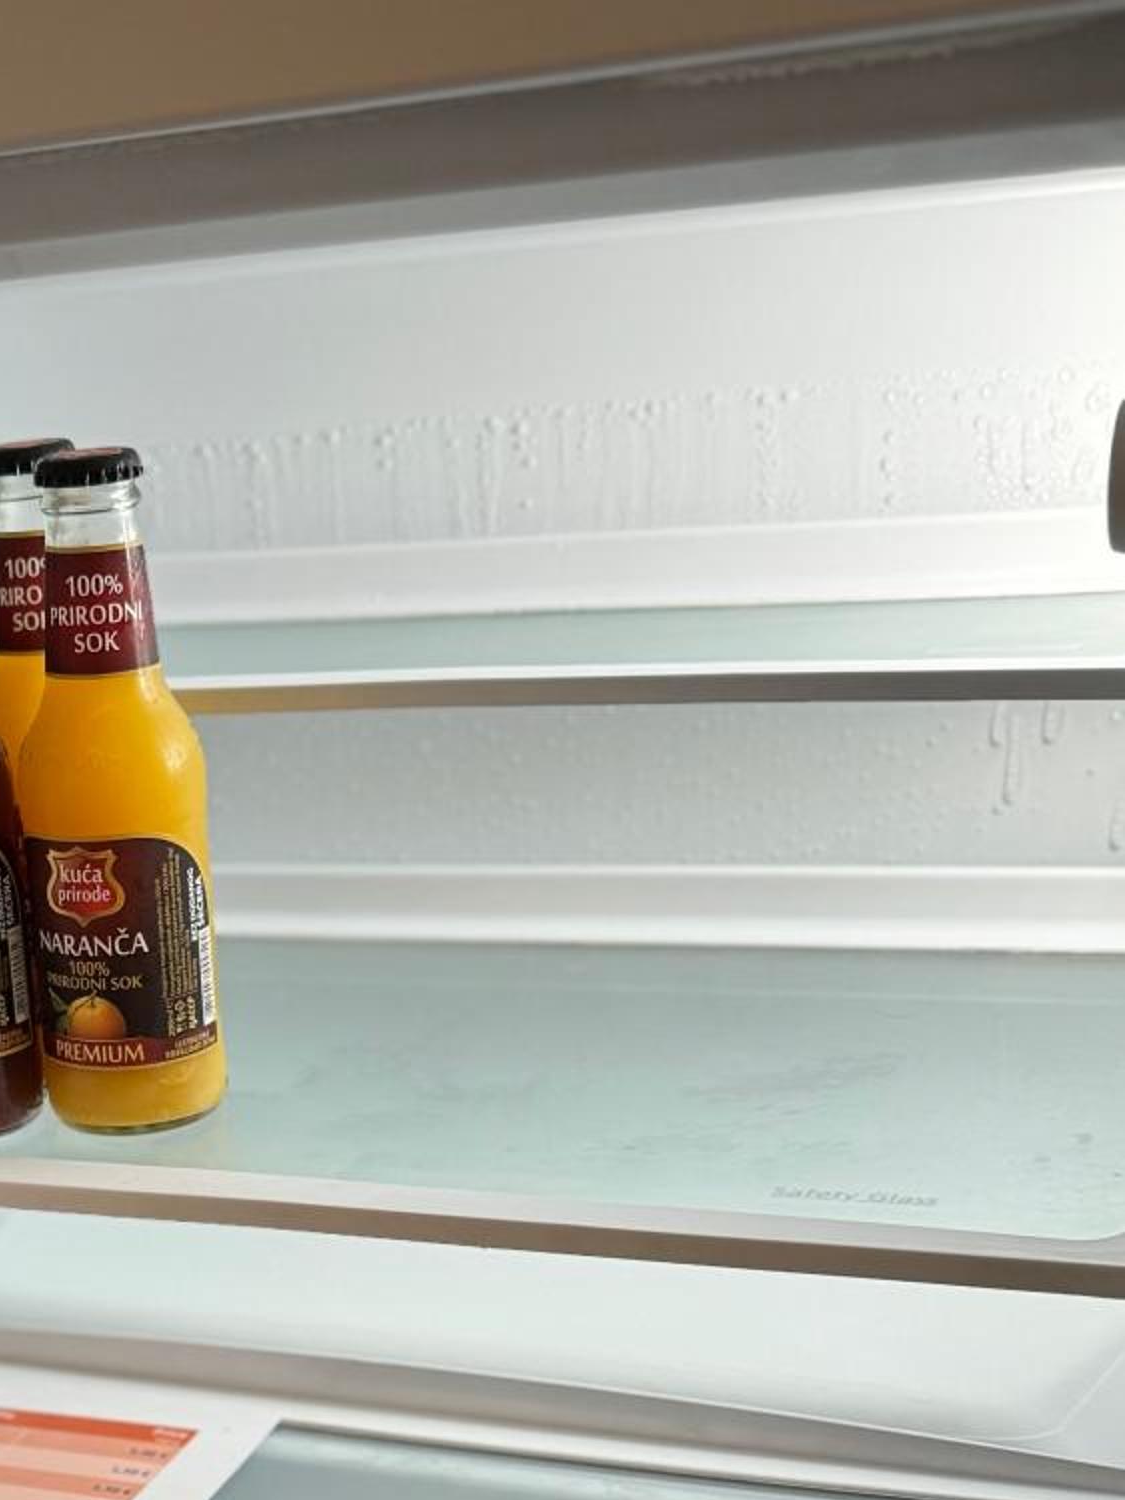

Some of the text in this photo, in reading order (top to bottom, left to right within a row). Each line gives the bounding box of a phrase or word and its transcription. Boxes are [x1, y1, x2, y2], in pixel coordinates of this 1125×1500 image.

[65, 575, 124, 598] 100%
[50, 601, 143, 626] PRIRODNI
[74, 631, 120, 653] SOK
[59, 863, 104, 884] kuća
[58, 886, 111, 906] prirode
[39, 927, 149, 957] NARANČA
[69, 960, 110, 976] 100%
[111, 973, 143, 991] SOK
[56, 1039, 145, 1063] PREMIUM
